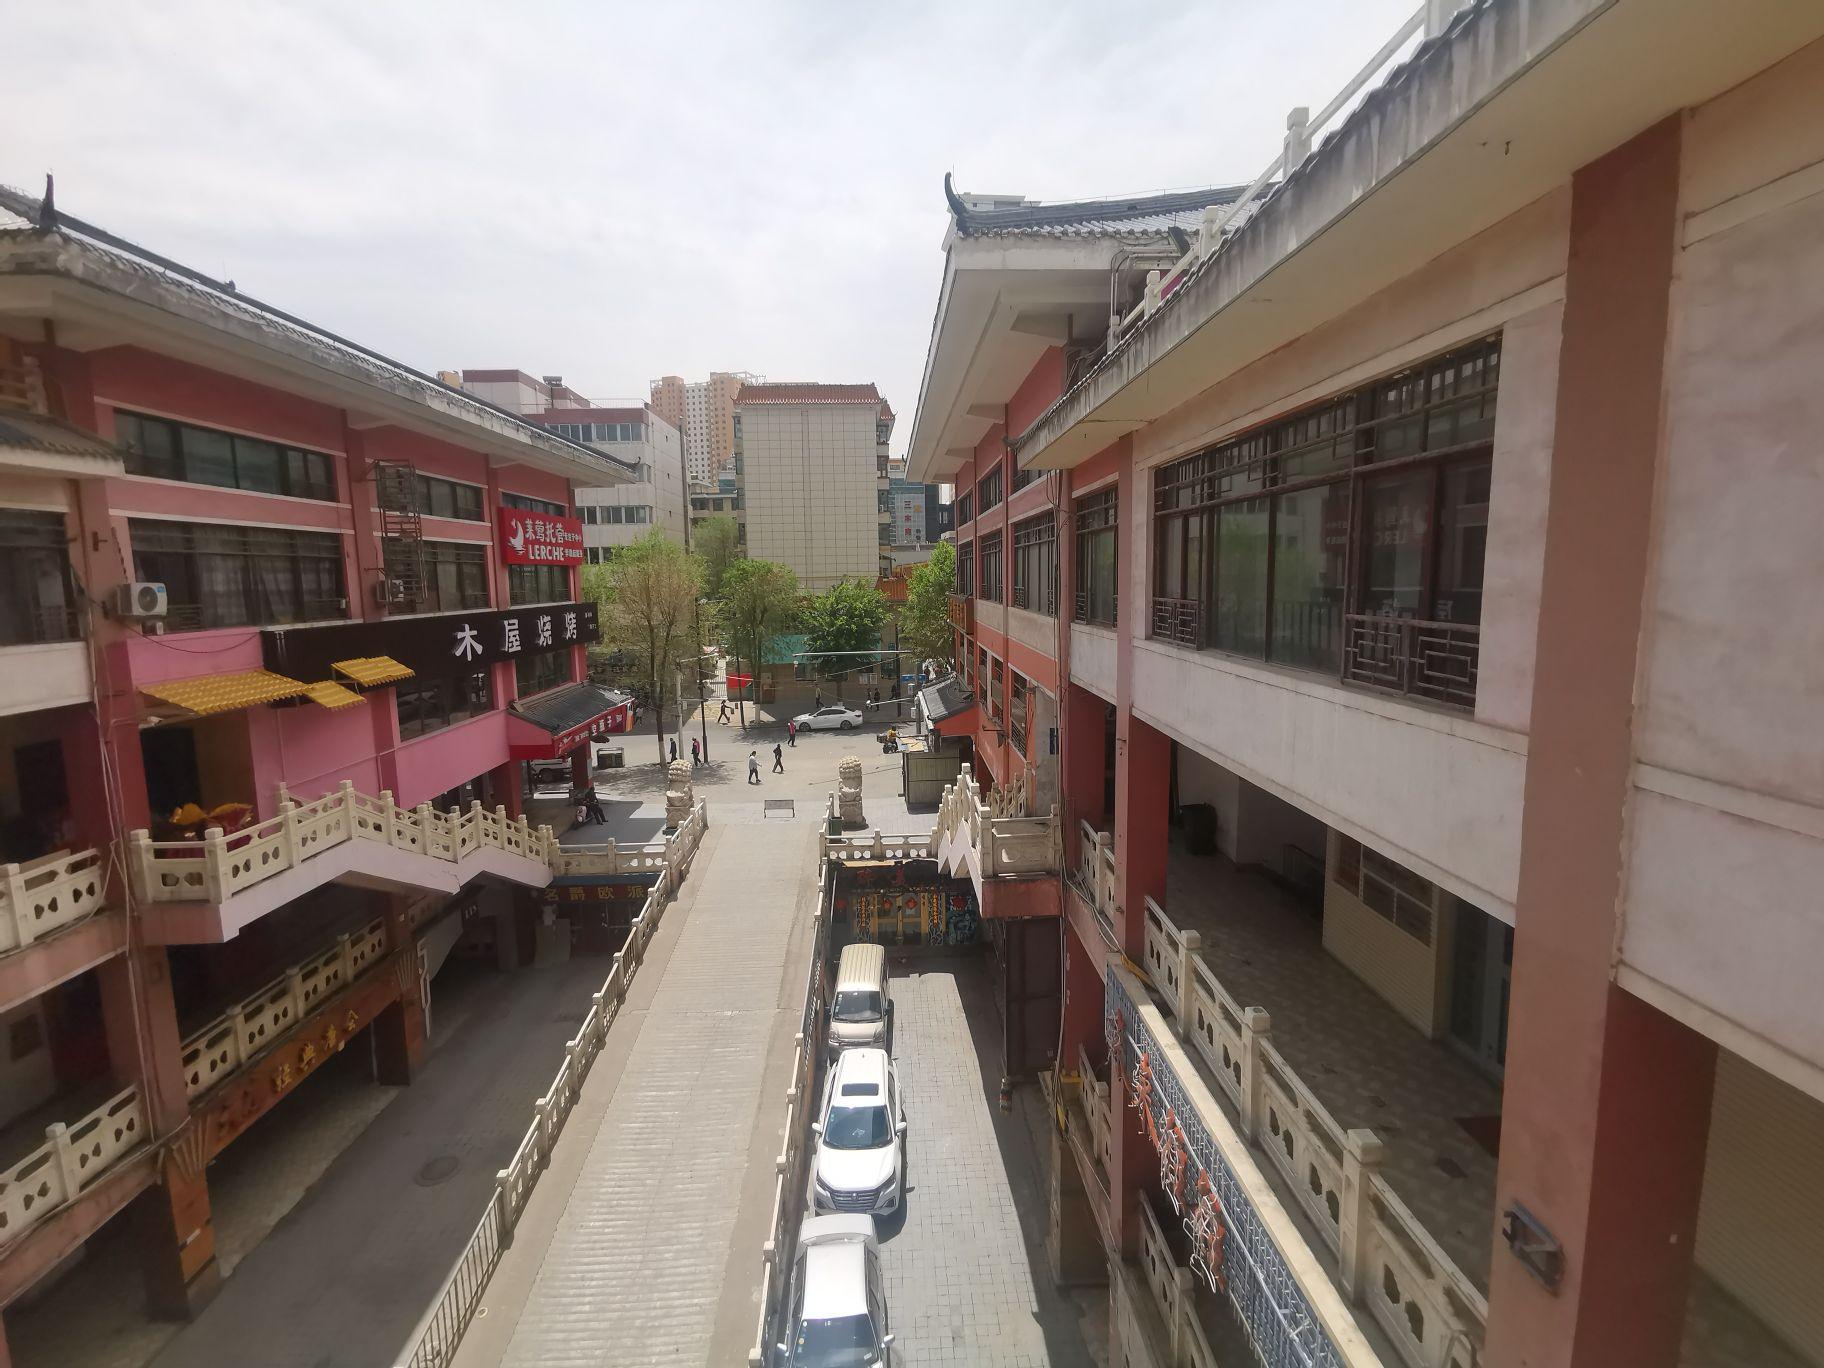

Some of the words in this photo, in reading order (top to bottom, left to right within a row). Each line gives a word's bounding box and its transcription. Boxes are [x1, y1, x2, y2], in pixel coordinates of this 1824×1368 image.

[528, 545, 564, 561] LERCHE
[454, 612, 577, 661] 木屋烧烤
